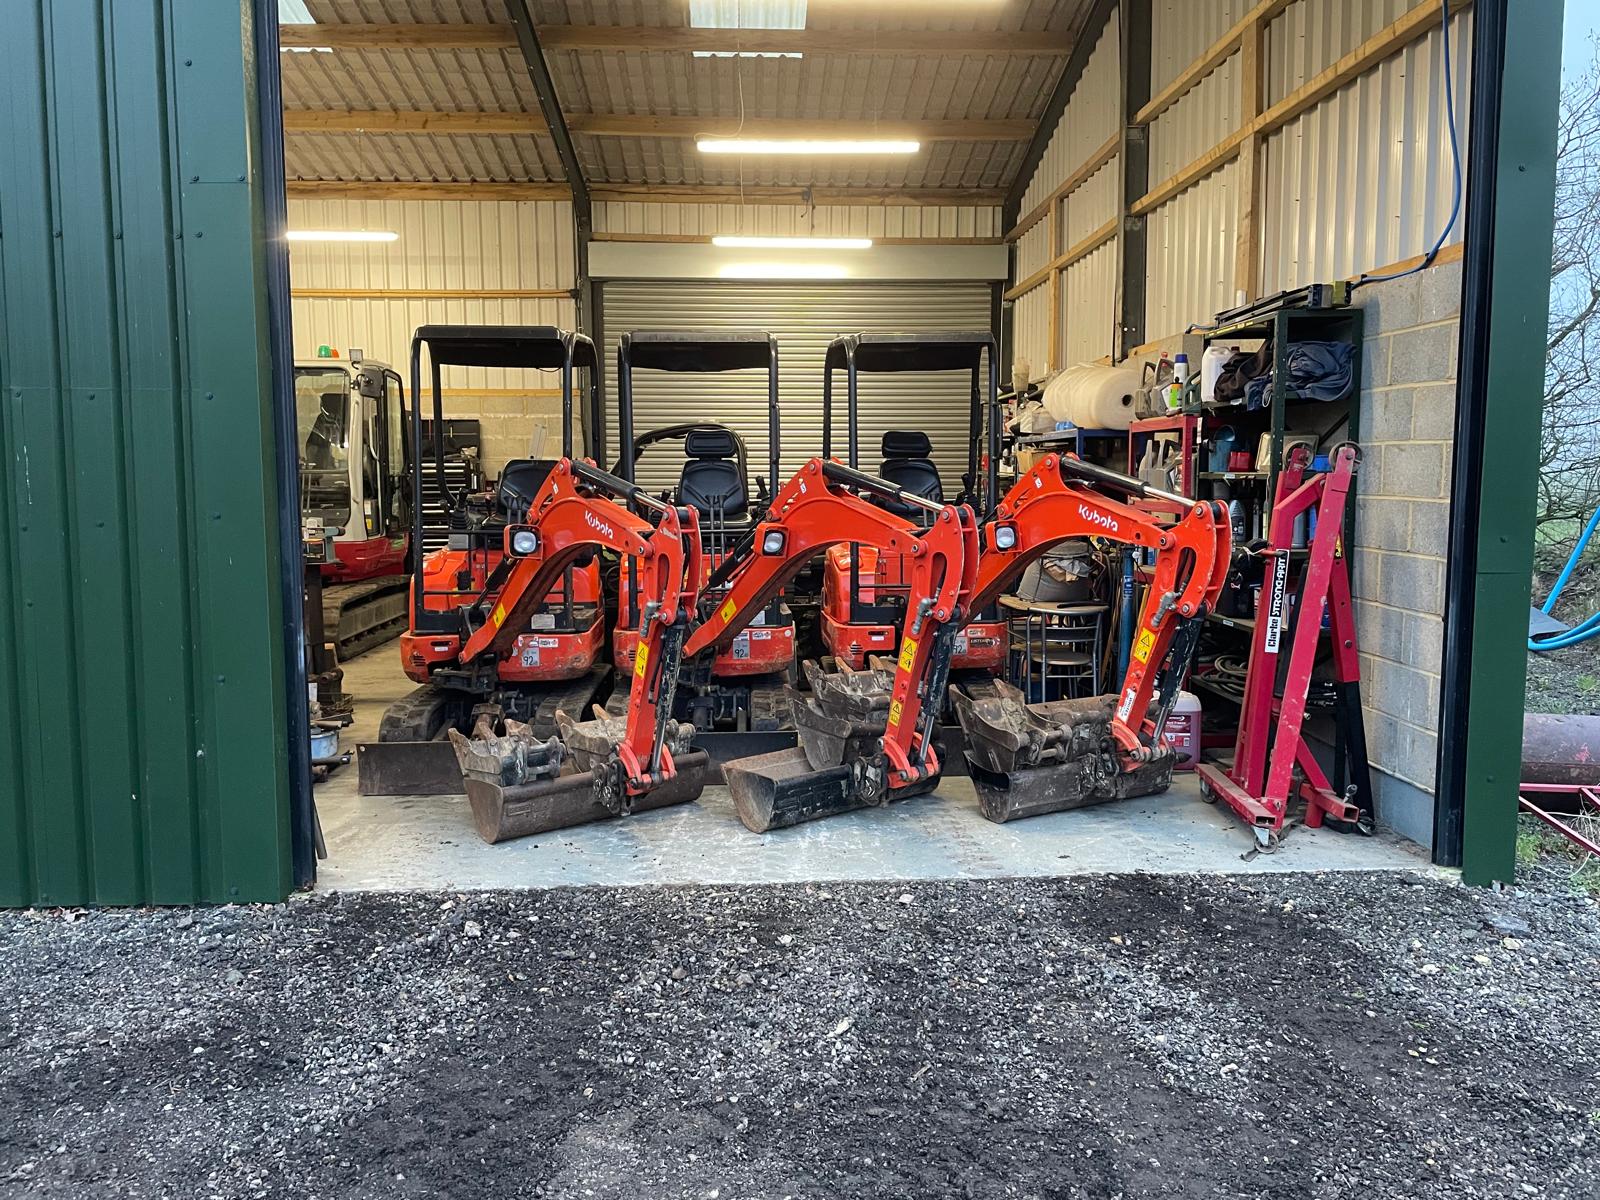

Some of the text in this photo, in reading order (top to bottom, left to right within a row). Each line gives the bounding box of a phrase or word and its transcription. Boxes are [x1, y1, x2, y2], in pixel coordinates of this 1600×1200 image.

[584, 510, 614, 539] Kubota
[1078, 504, 1119, 532] Kubota
[1267, 618, 1279, 647] Clarke
[523, 655, 534, 666] 92
[735, 649, 745, 658] 92
